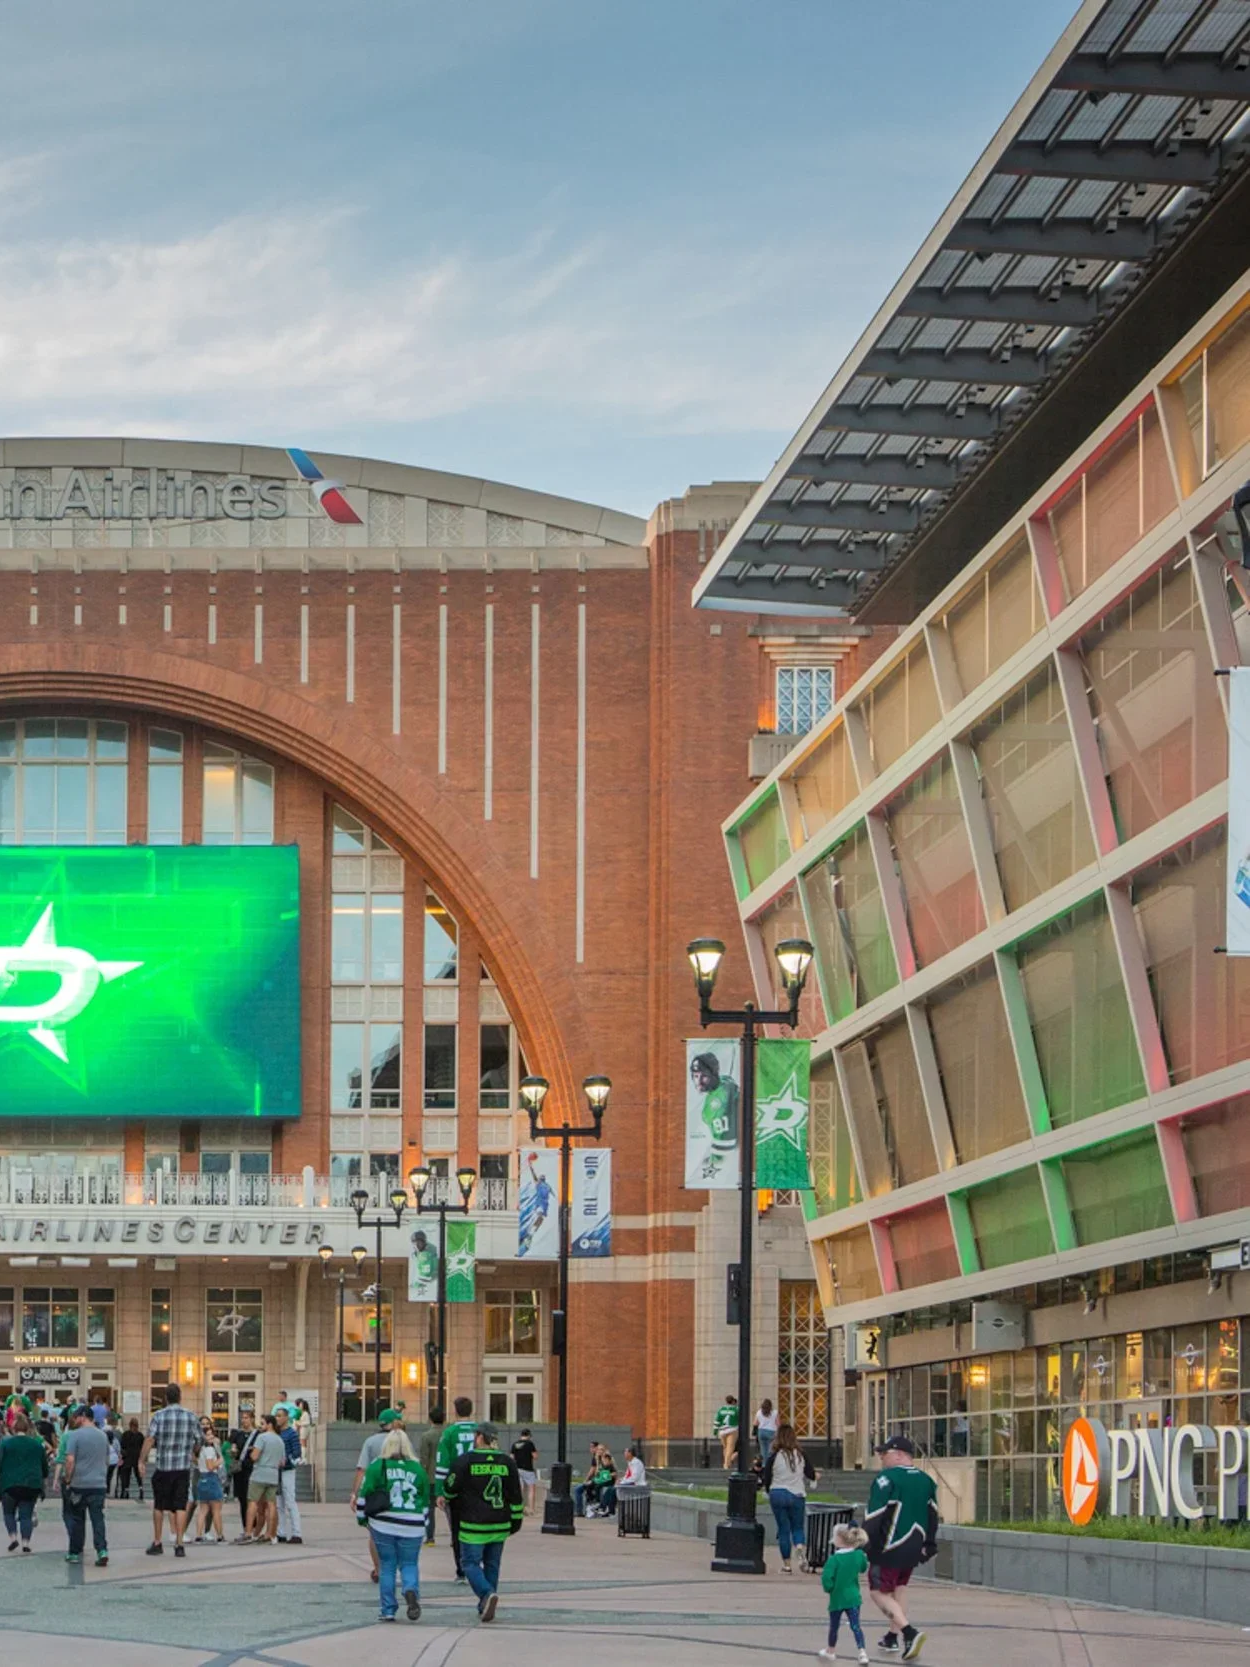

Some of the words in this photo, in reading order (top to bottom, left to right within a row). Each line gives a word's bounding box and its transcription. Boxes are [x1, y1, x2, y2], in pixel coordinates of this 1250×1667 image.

[53, 470, 288, 521] Airlines
[44, 1355, 87, 1364] ENTRANCE
[482, 1475, 505, 1509] 4
[1108, 1424, 1204, 1520] PNC
